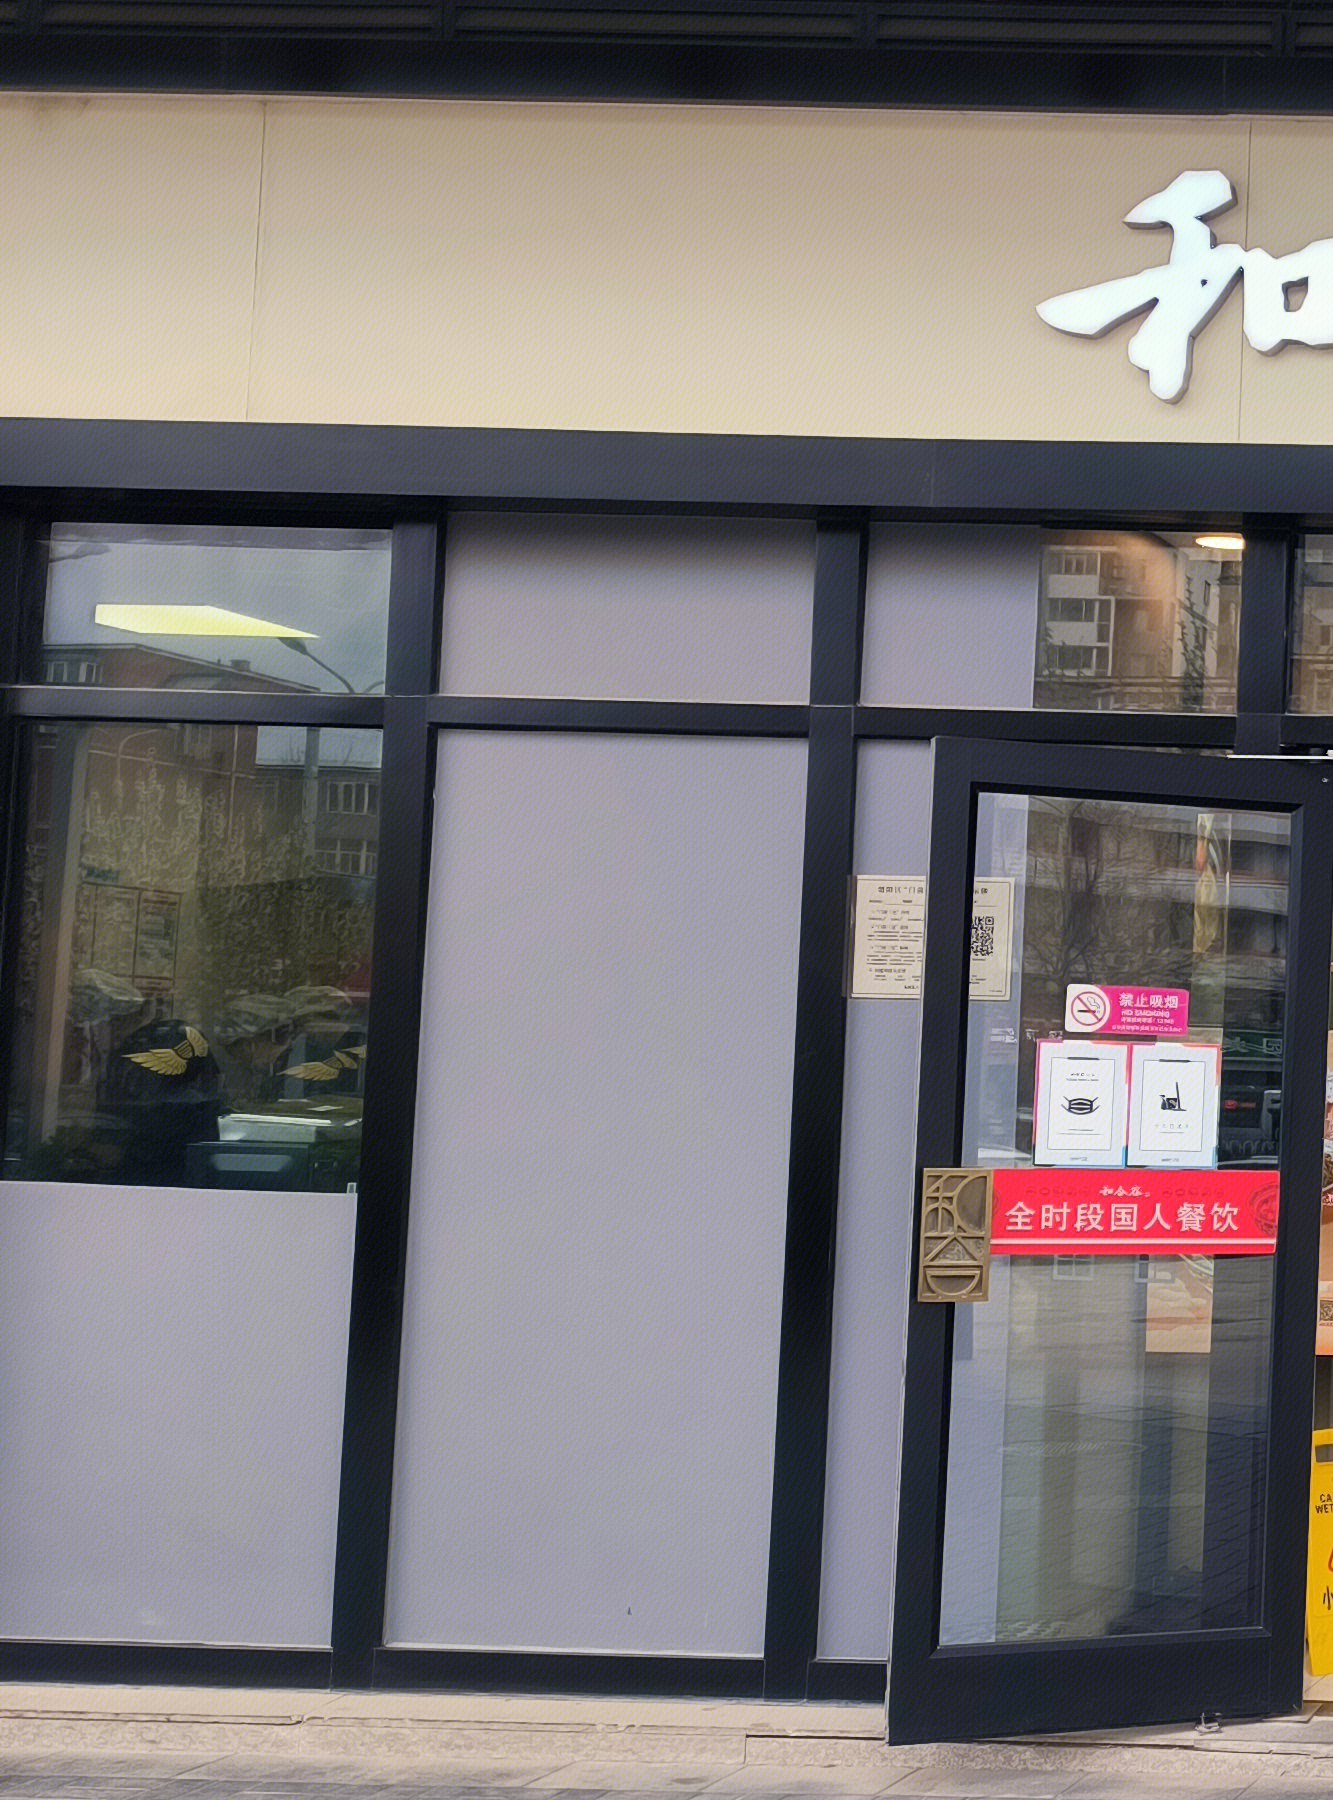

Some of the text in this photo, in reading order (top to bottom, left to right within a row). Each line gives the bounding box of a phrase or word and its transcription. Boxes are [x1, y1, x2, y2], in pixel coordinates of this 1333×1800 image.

[1119, 992, 1179, 1009] 禁止吸烟
[1004, 1201, 1240, 1233] 全时段国人餐饮
[1315, 1503, 1333, 1514] WET
